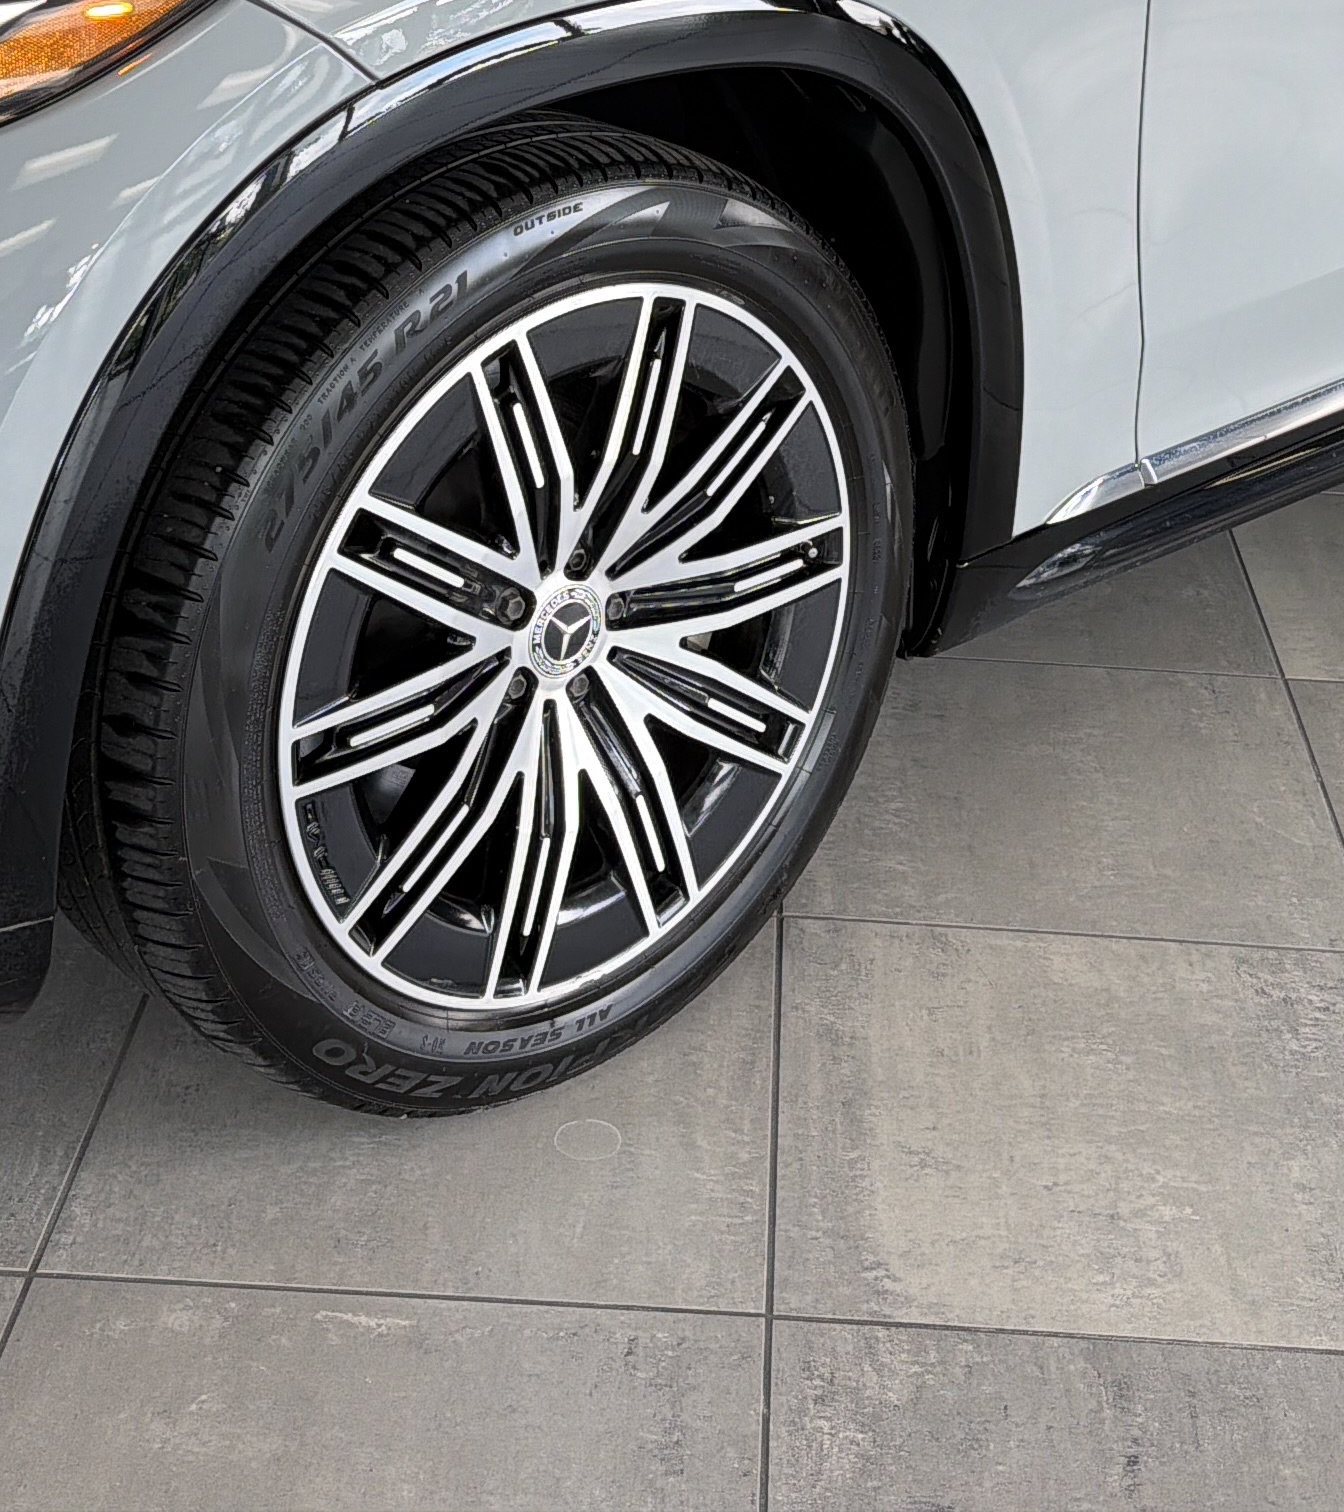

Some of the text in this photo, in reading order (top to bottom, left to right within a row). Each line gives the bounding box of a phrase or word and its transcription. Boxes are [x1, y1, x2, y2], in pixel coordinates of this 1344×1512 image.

[513, 201, 584, 238] OUTSIDE
[317, 364, 352, 405] TRACTION
[358, 300, 410, 352] TEMPERATURE
[263, 348, 385, 554] 275/45
[393, 269, 471, 356] R21
[532, 590, 571, 645] MERCEDES
[463, 1003, 615, 1055] ALL SEASON
[311, 1035, 464, 1099] ZERO
